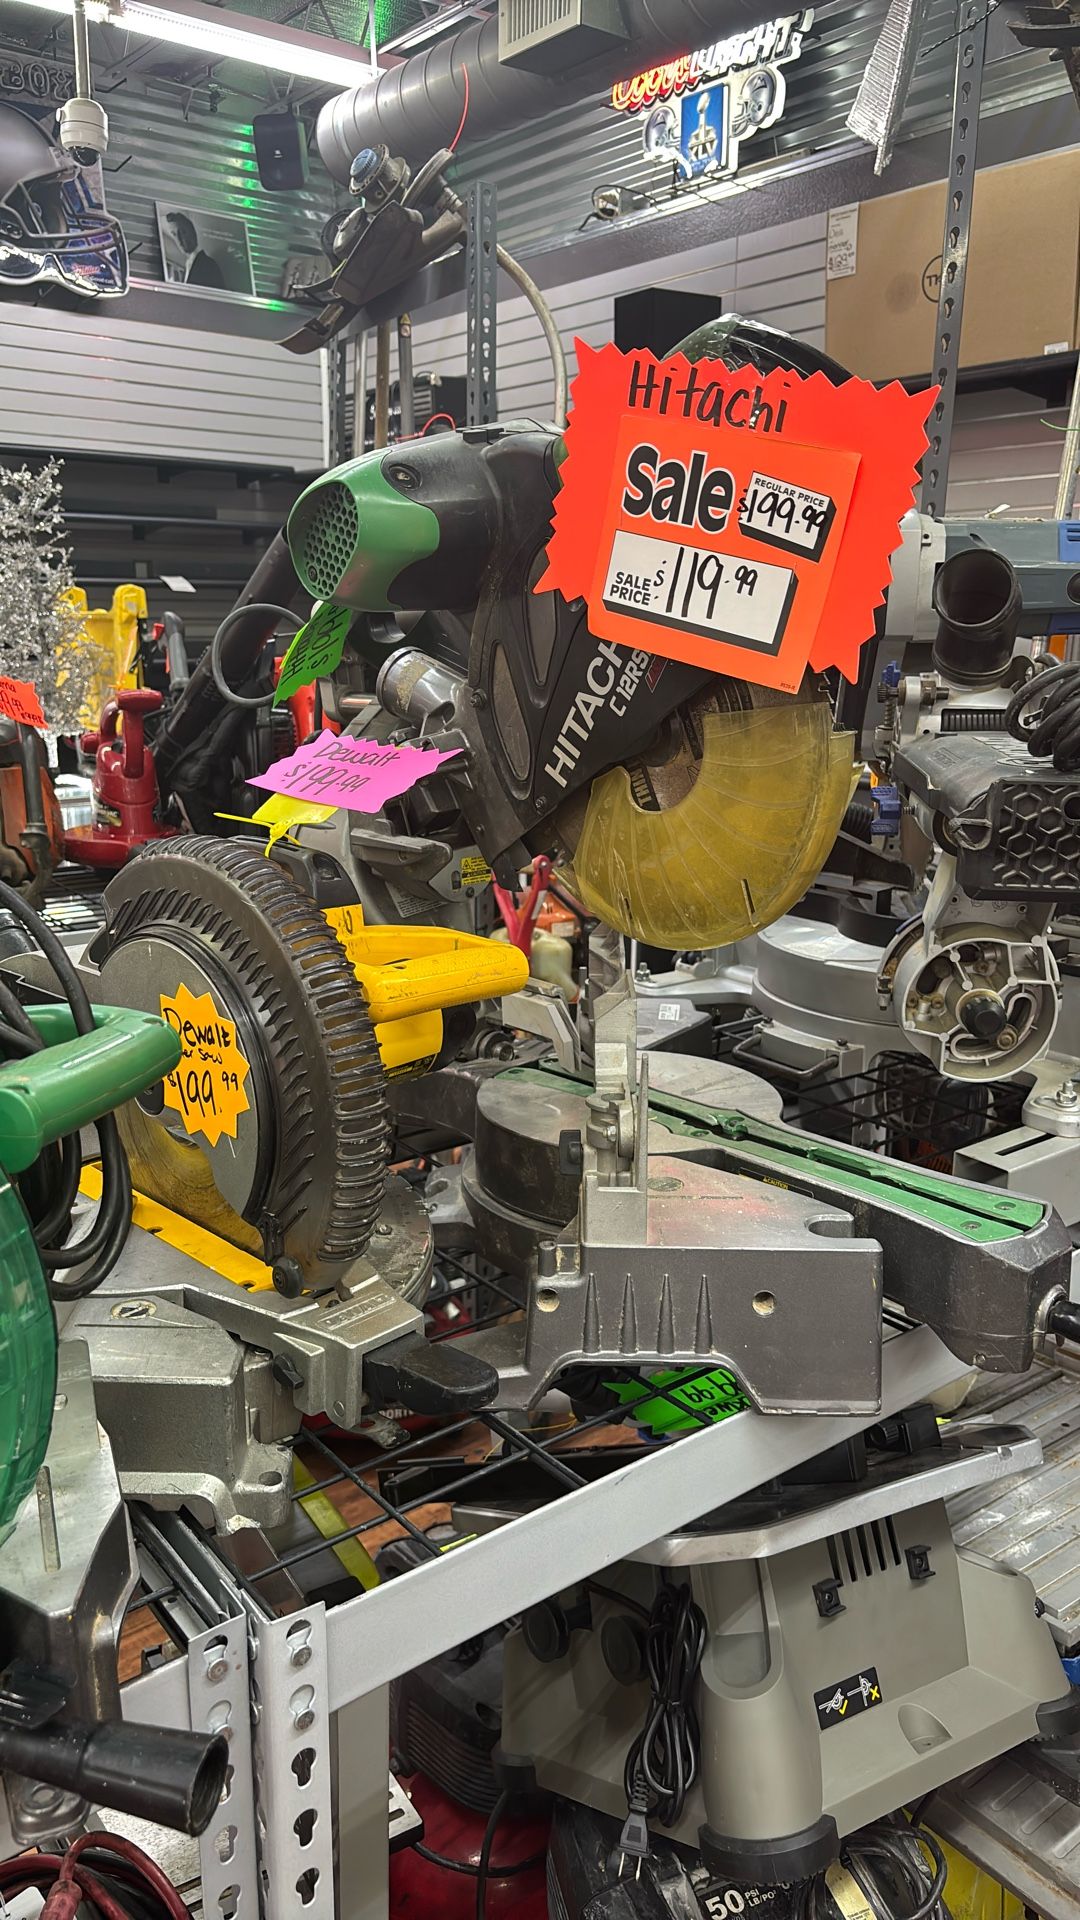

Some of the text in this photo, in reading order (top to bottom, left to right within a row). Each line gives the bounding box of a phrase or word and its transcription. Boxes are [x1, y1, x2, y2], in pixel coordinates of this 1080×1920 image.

[628, 360, 788, 433] Hitachi
[622, 443, 734, 533] Sale
[754, 477, 826, 508] REGULAR PRICE
[737, 488, 828, 541] $199.99
[610, 584, 651, 606] PRICE
[615, 571, 651, 592] SALE
[653, 546, 758, 620] $119.99
[615, 649, 651, 701] 12RS
[281, 761, 371, 796] $199.99
[167, 1070, 239, 1118] $199.99
[705, 1889, 745, 1920] 50
[744, 1889, 760, 1900] PSI
